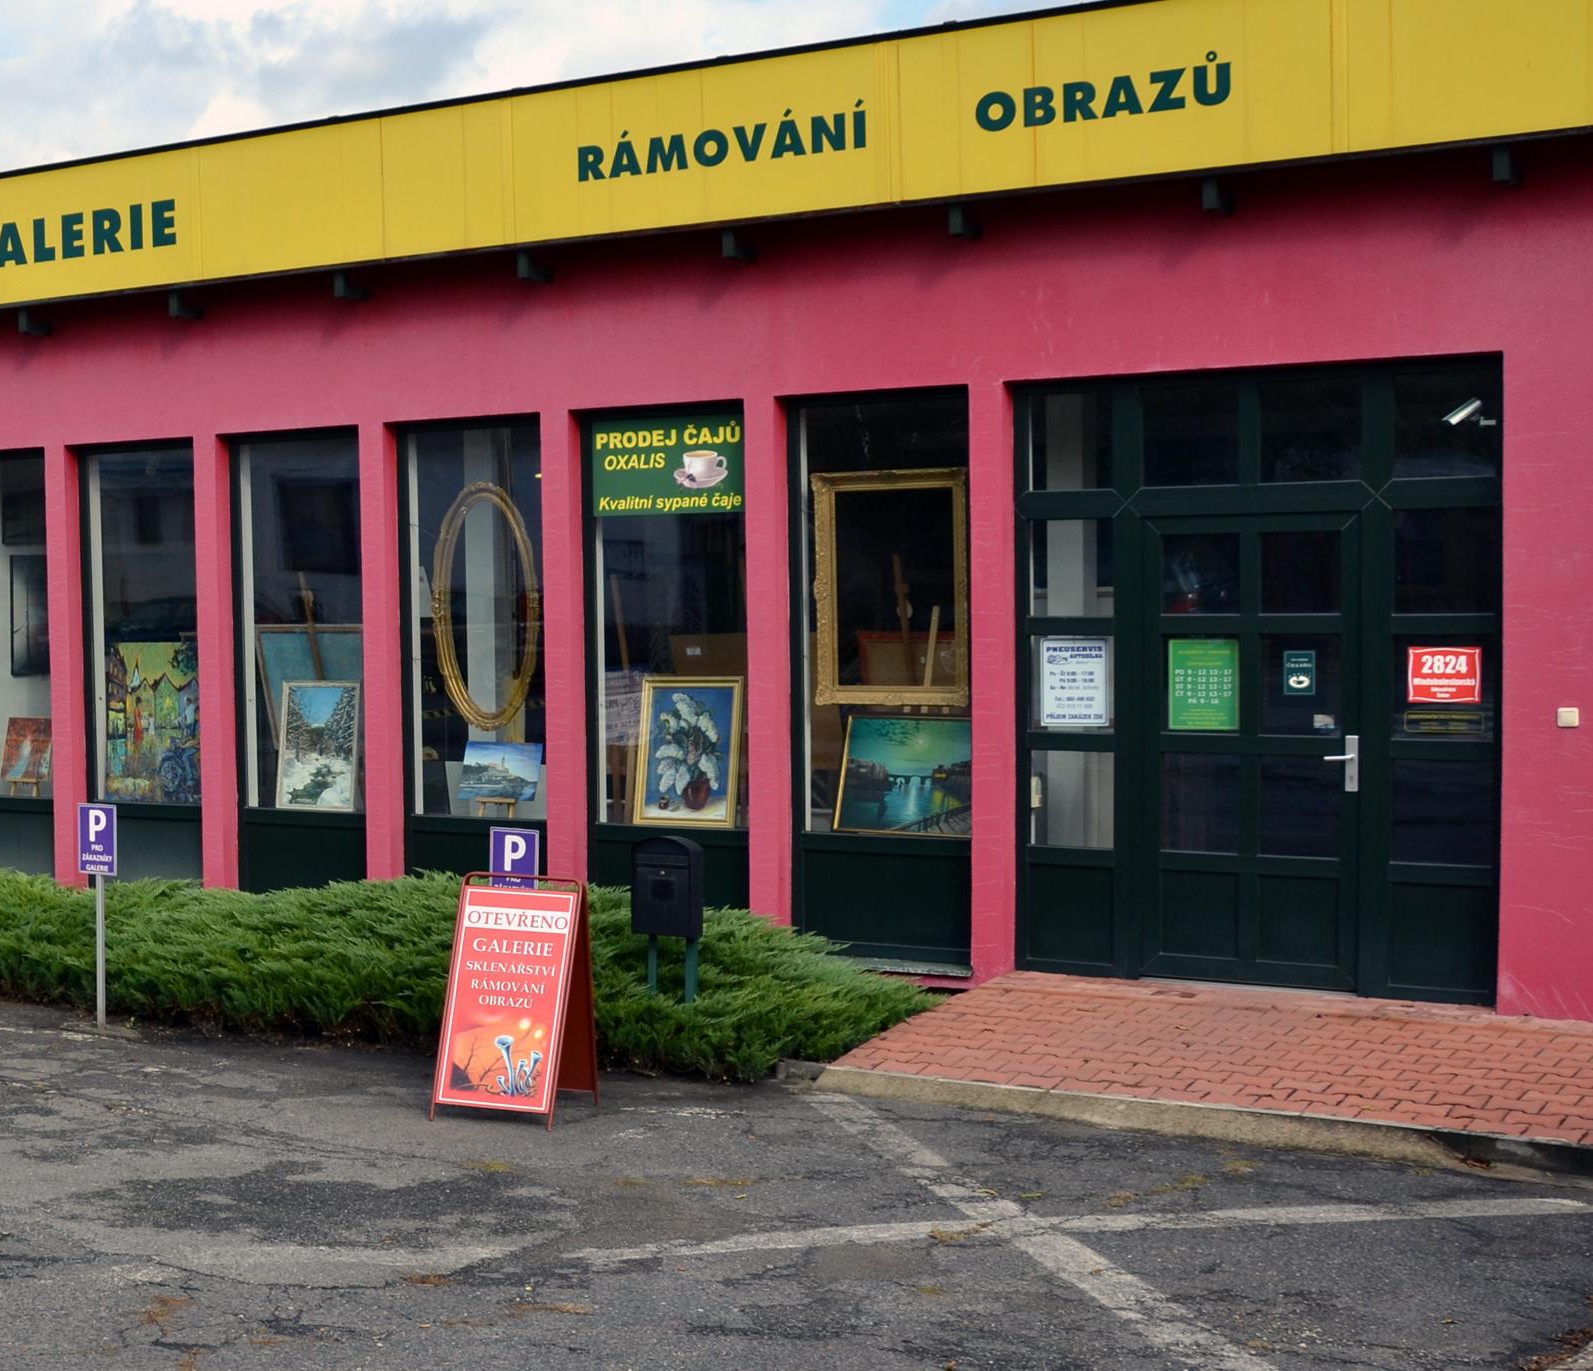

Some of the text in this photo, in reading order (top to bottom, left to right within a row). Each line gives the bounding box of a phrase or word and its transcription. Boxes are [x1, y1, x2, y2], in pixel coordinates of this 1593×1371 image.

[577, 50, 1232, 182] RÁMOVÁNÍ OBRAZŮ
[595, 420, 741, 450] PRODEJ ČAJŮ
[604, 452, 666, 471] OXALIS
[599, 492, 742, 512] Kvalitní sypané čaje
[1421, 654, 1468, 674] 2824
[88, 809, 107, 842] P
[82, 852, 113, 863] ZÁKAZNÍKY
[91, 844, 104, 852] PRO
[503, 834, 527, 872] P
[85, 863, 109, 872] GALERIE
[467, 908, 569, 931] OTEVŘENO
[472, 937, 554, 957] GALERIE
[465, 959, 557, 977] SKLENÁŘSTVÍ
[470, 977, 546, 995] RÁMOVÁNÍ
